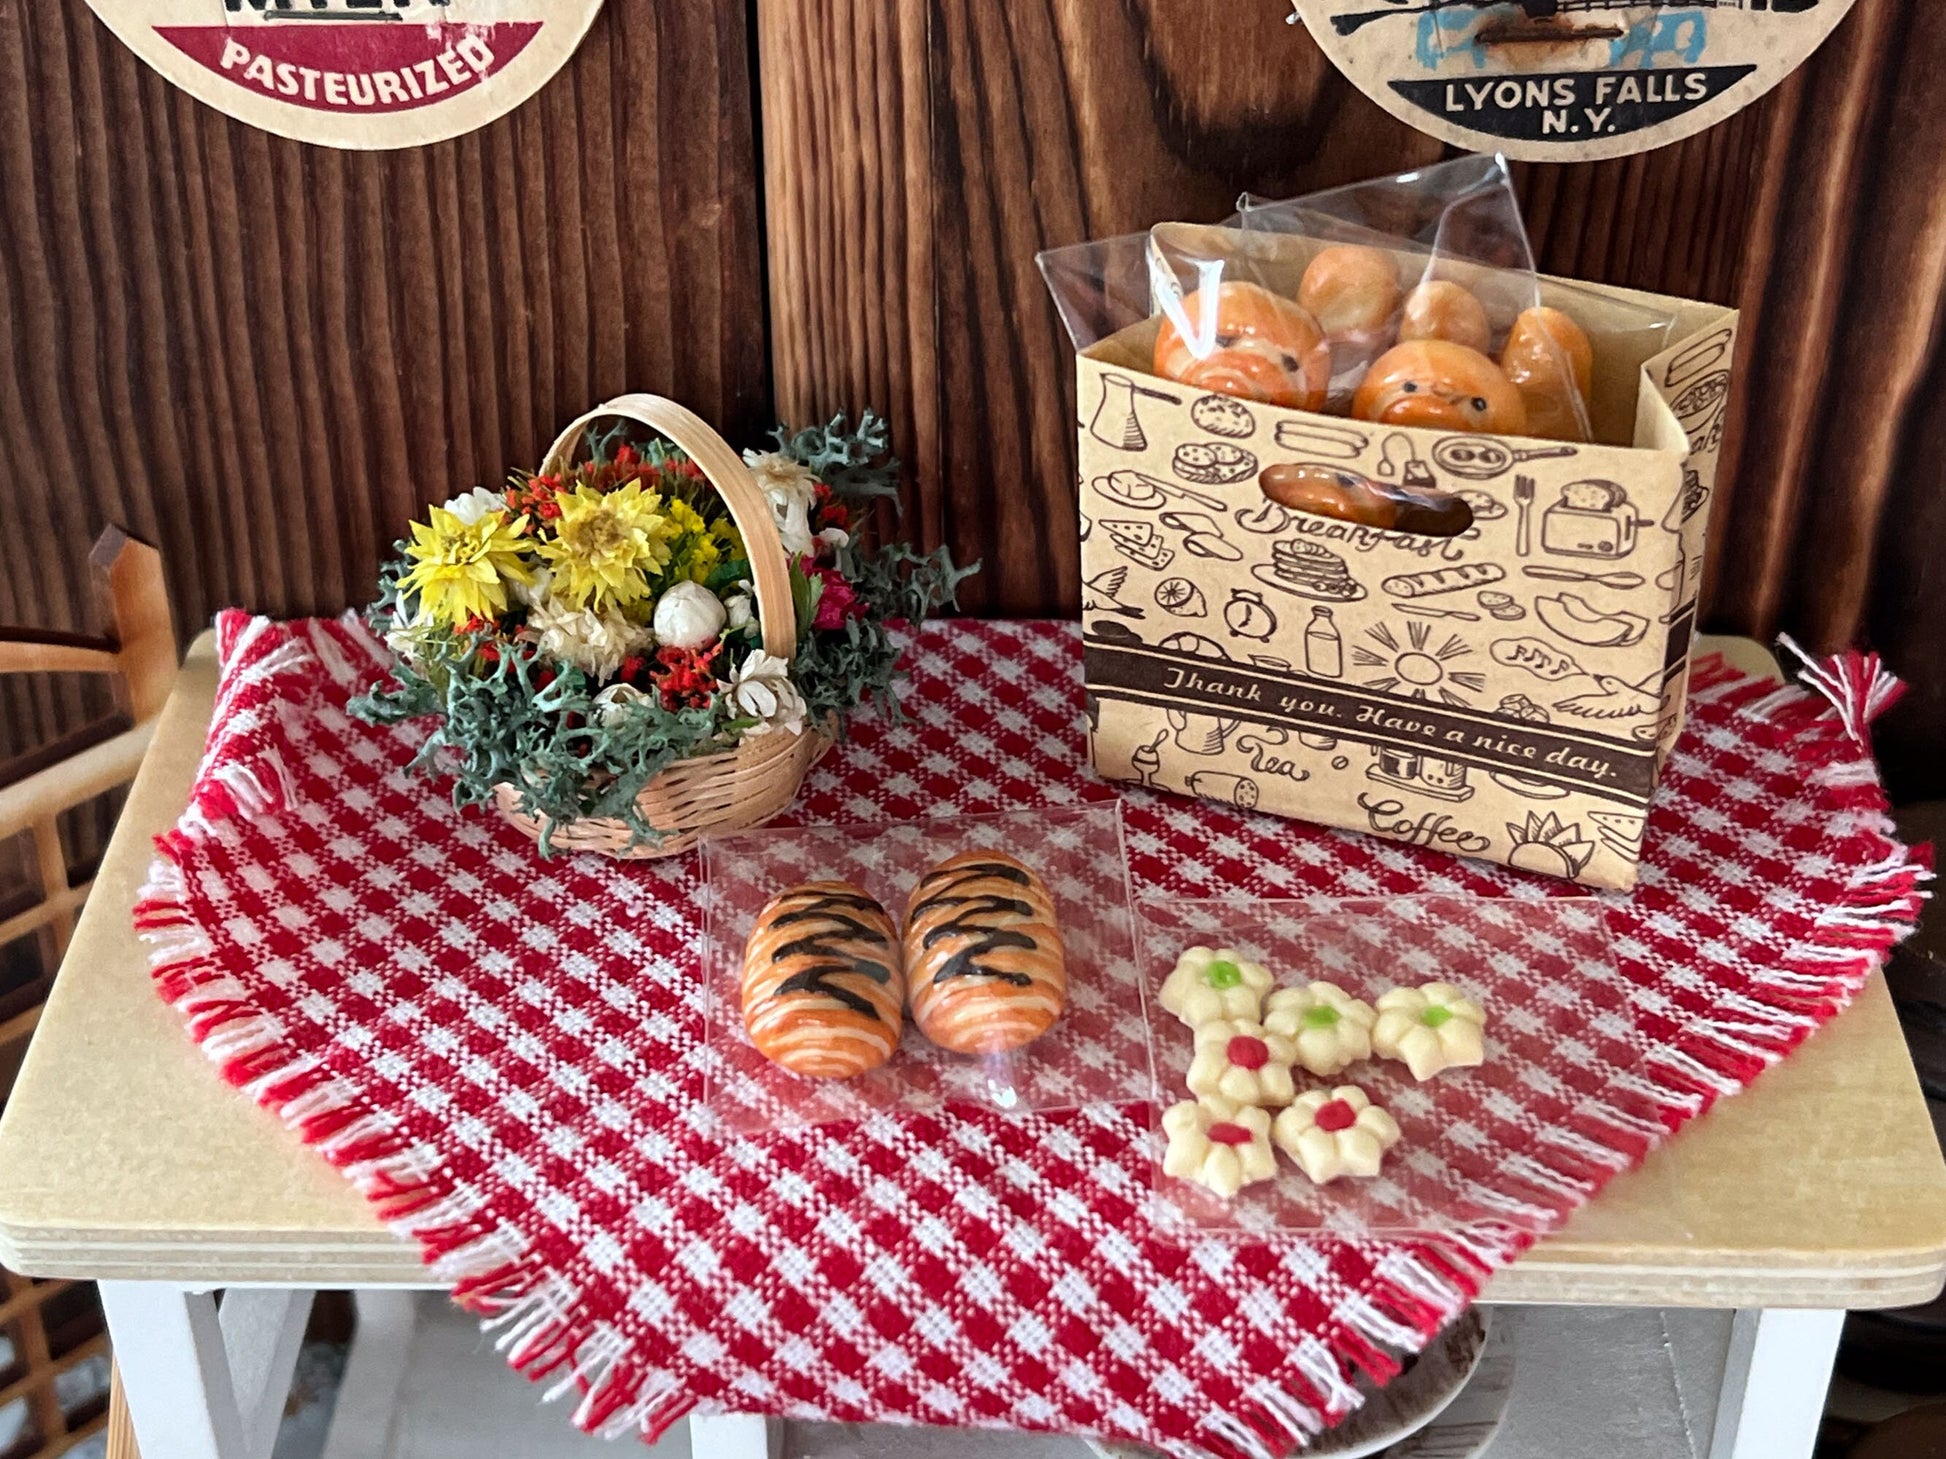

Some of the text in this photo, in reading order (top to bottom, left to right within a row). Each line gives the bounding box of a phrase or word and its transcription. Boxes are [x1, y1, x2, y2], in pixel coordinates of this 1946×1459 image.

[220, 35, 495, 106] PASTEURIZED
[1445, 72, 1708, 112] LYONS FALLS
[1542, 107, 1616, 135] N.Y.
[1164, 667, 1618, 779] Thank you. Have a nice day.
[1236, 725, 1310, 781] Tea
[1357, 792, 1491, 852] Coffee
